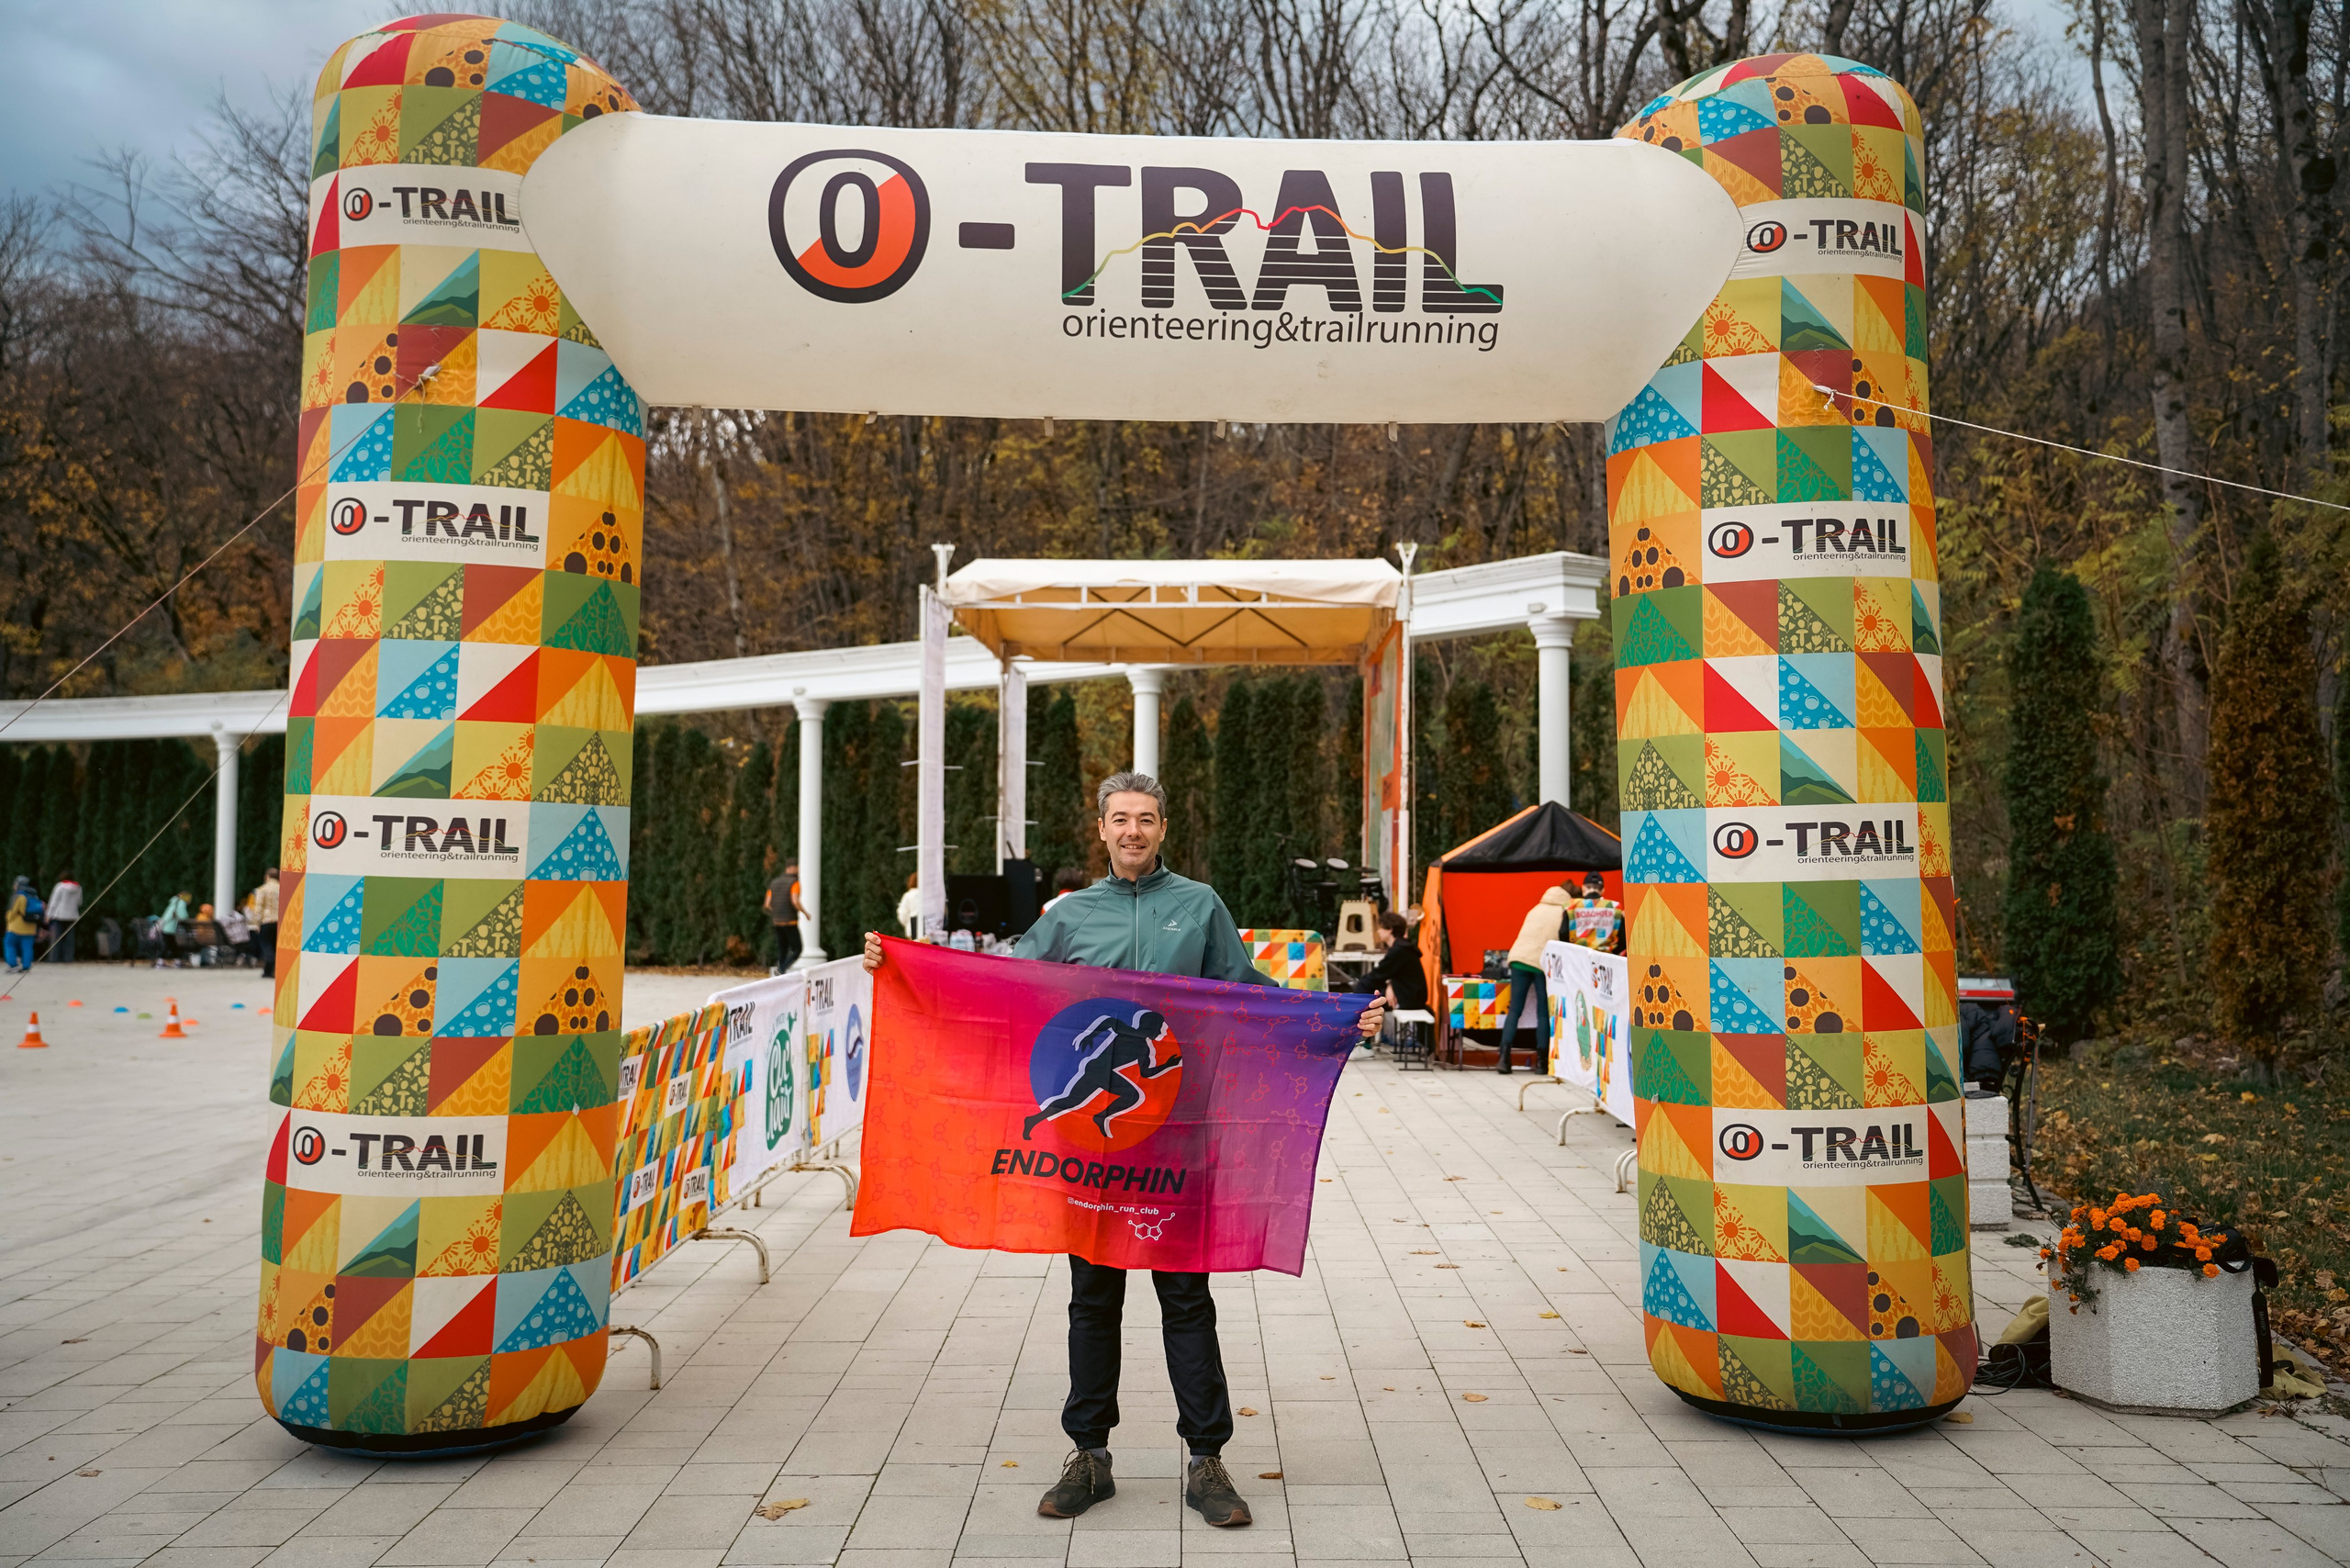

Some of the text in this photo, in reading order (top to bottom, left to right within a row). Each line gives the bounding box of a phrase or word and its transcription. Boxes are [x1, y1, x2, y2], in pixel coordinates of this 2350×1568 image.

[403, 218, 520, 234] orienteering&trailrunning
[1818, 248, 1903, 263] orienteering&trailrunning
[1062, 308, 1499, 352] orienteering&trailrunning
[401, 534, 539, 552] orienteering&trailrunning
[1793, 552, 1906, 563] orienteering&trailrunning
[380, 851, 519, 863] orienteering&trailrunning
[1797, 854, 1914, 864] orienteering&trailrunning
[1802, 1158, 1923, 1170] orienteering&trailrunning
[358, 1169, 497, 1180] orienteering&trailrunning
[990, 1148, 1187, 1194] ENDORPHIN
